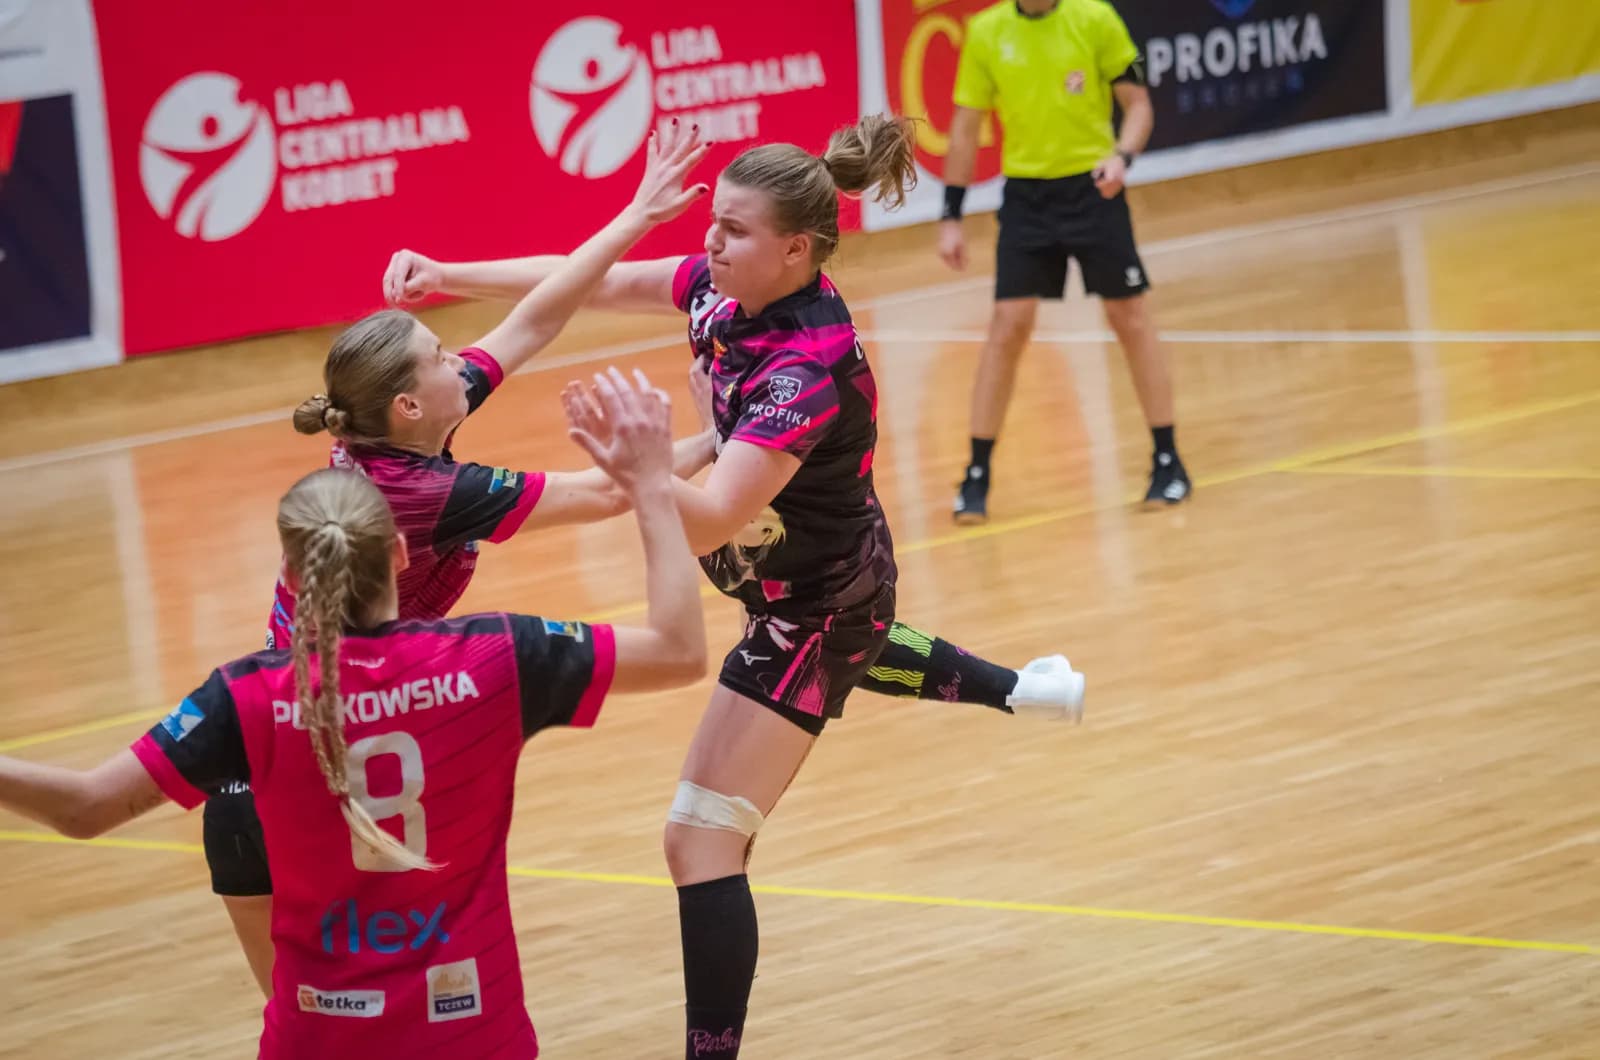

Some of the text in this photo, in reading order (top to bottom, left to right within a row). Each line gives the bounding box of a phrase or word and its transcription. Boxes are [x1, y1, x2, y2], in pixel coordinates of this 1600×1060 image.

[651, 25, 722, 70] LIGA
[1146, 12, 1328, 87] PROFIKA
[274, 79, 354, 126] LIGA
[653, 51, 826, 112] CENTRALNA
[278, 105, 470, 169] CENTRALNA
[281, 156, 398, 212] KOBIET
[748, 403, 811, 428] PROFIKA
[347, 731, 428, 872] 8
[321, 897, 449, 954] flex
